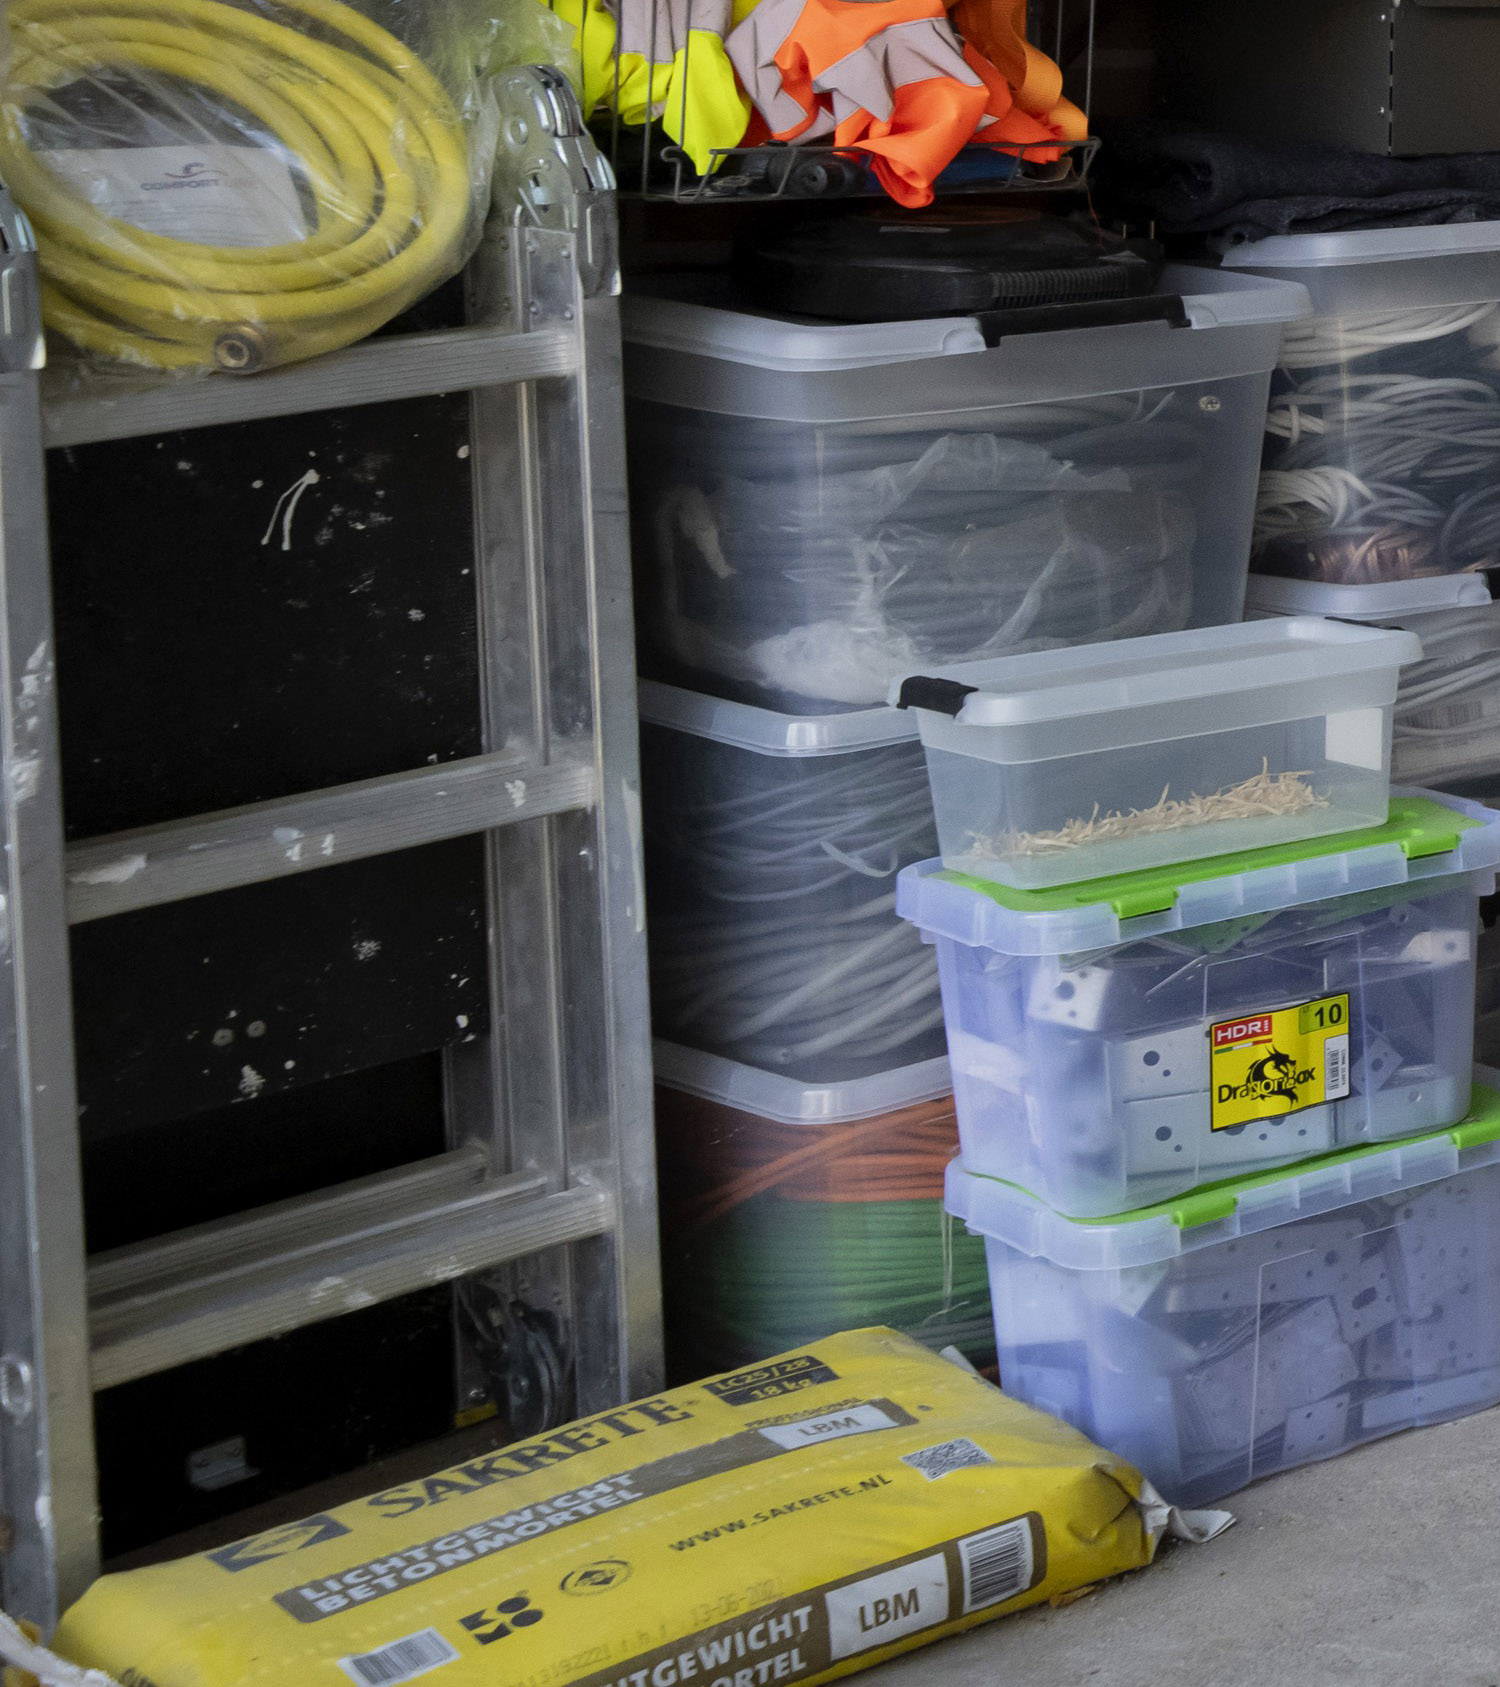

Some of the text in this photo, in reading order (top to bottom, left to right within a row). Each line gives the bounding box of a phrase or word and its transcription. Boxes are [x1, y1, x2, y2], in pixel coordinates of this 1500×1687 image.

[1216, 1021, 1263, 1042] HDR
[1314, 1003, 1342, 1028] 10
[751, 1377, 814, 1401] 18 kg
[800, 1415, 861, 1437] LBM
[366, 1398, 695, 1519] SAKRETE
[669, 1472, 893, 1552] WWW.SAKRETE.NL
[300, 1473, 637, 1602] LICHTGEWICHT
[312, 1488, 645, 1614] BETONMORTEL
[859, 1587, 920, 1633] LBM
